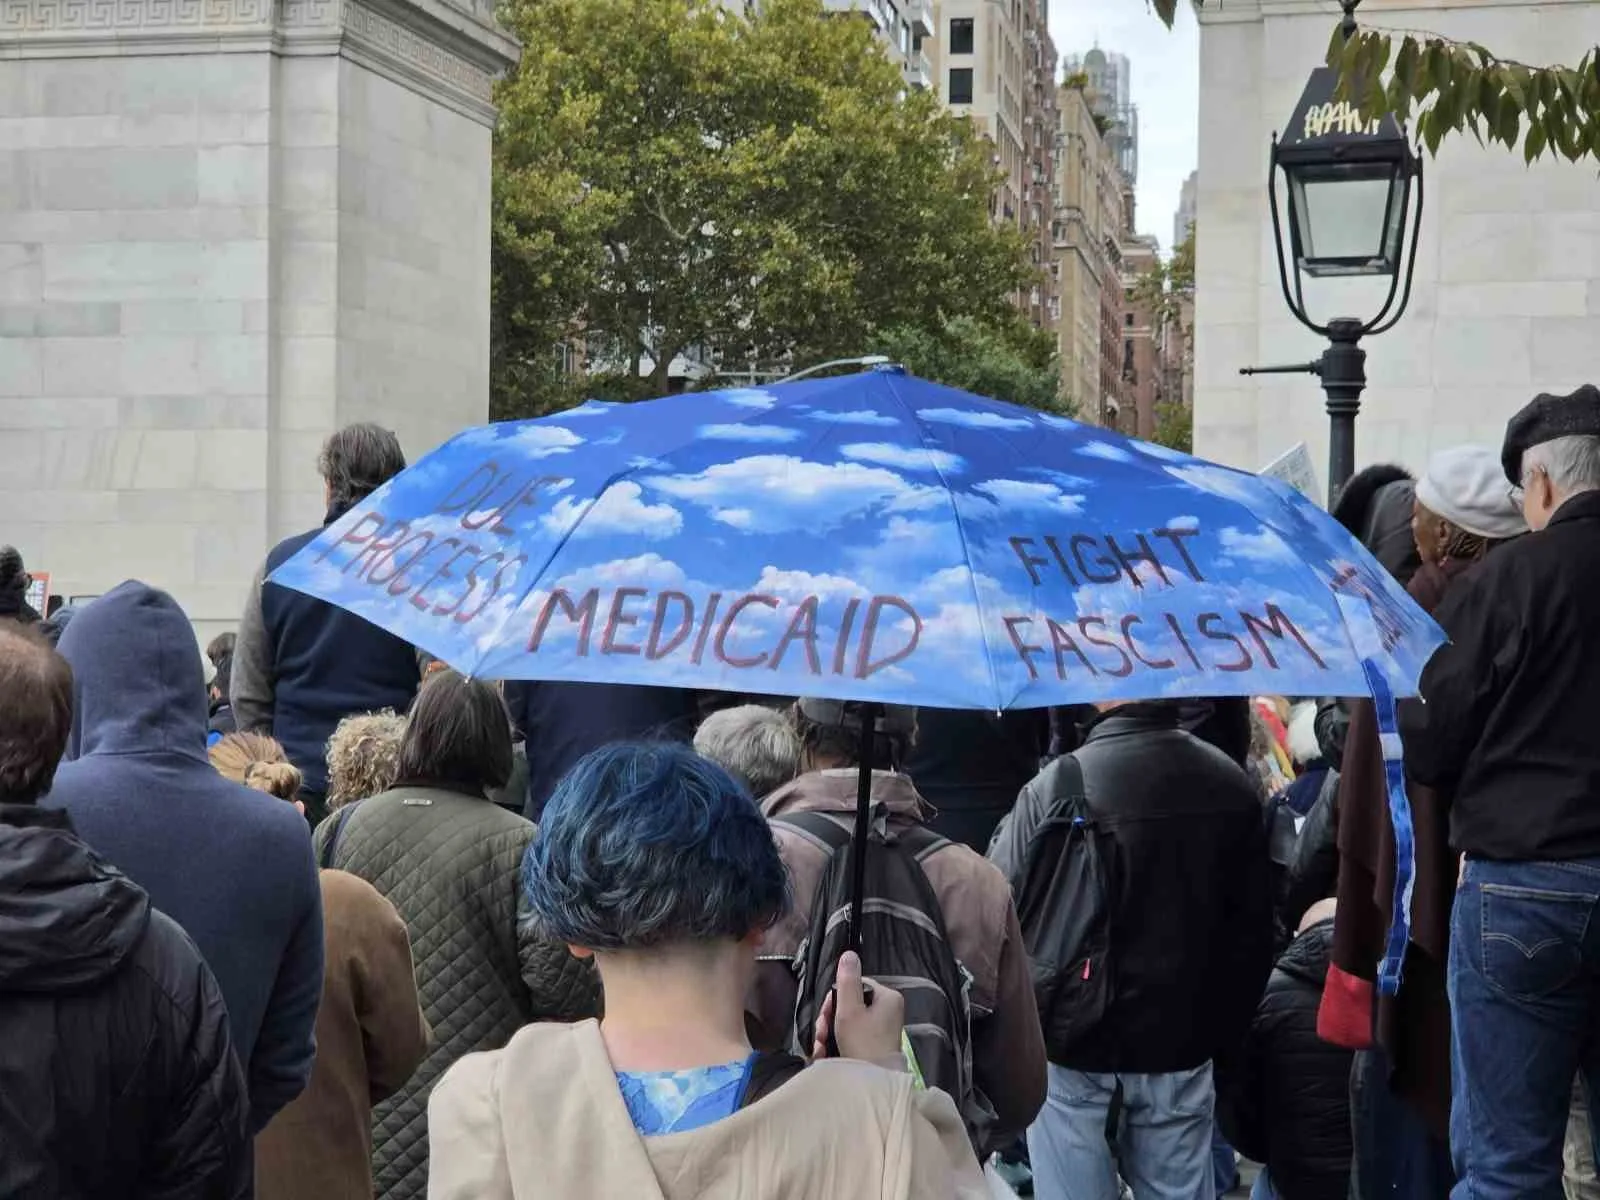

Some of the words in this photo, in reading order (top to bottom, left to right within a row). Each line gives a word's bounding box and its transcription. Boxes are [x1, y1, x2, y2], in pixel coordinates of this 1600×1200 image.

[439, 460, 565, 536] DUE
[313, 511, 528, 623] PROCESS
[1008, 528, 1206, 589] FIGHT
[527, 587, 923, 680] MEDICAID
[1002, 602, 1329, 681] FASCISM
